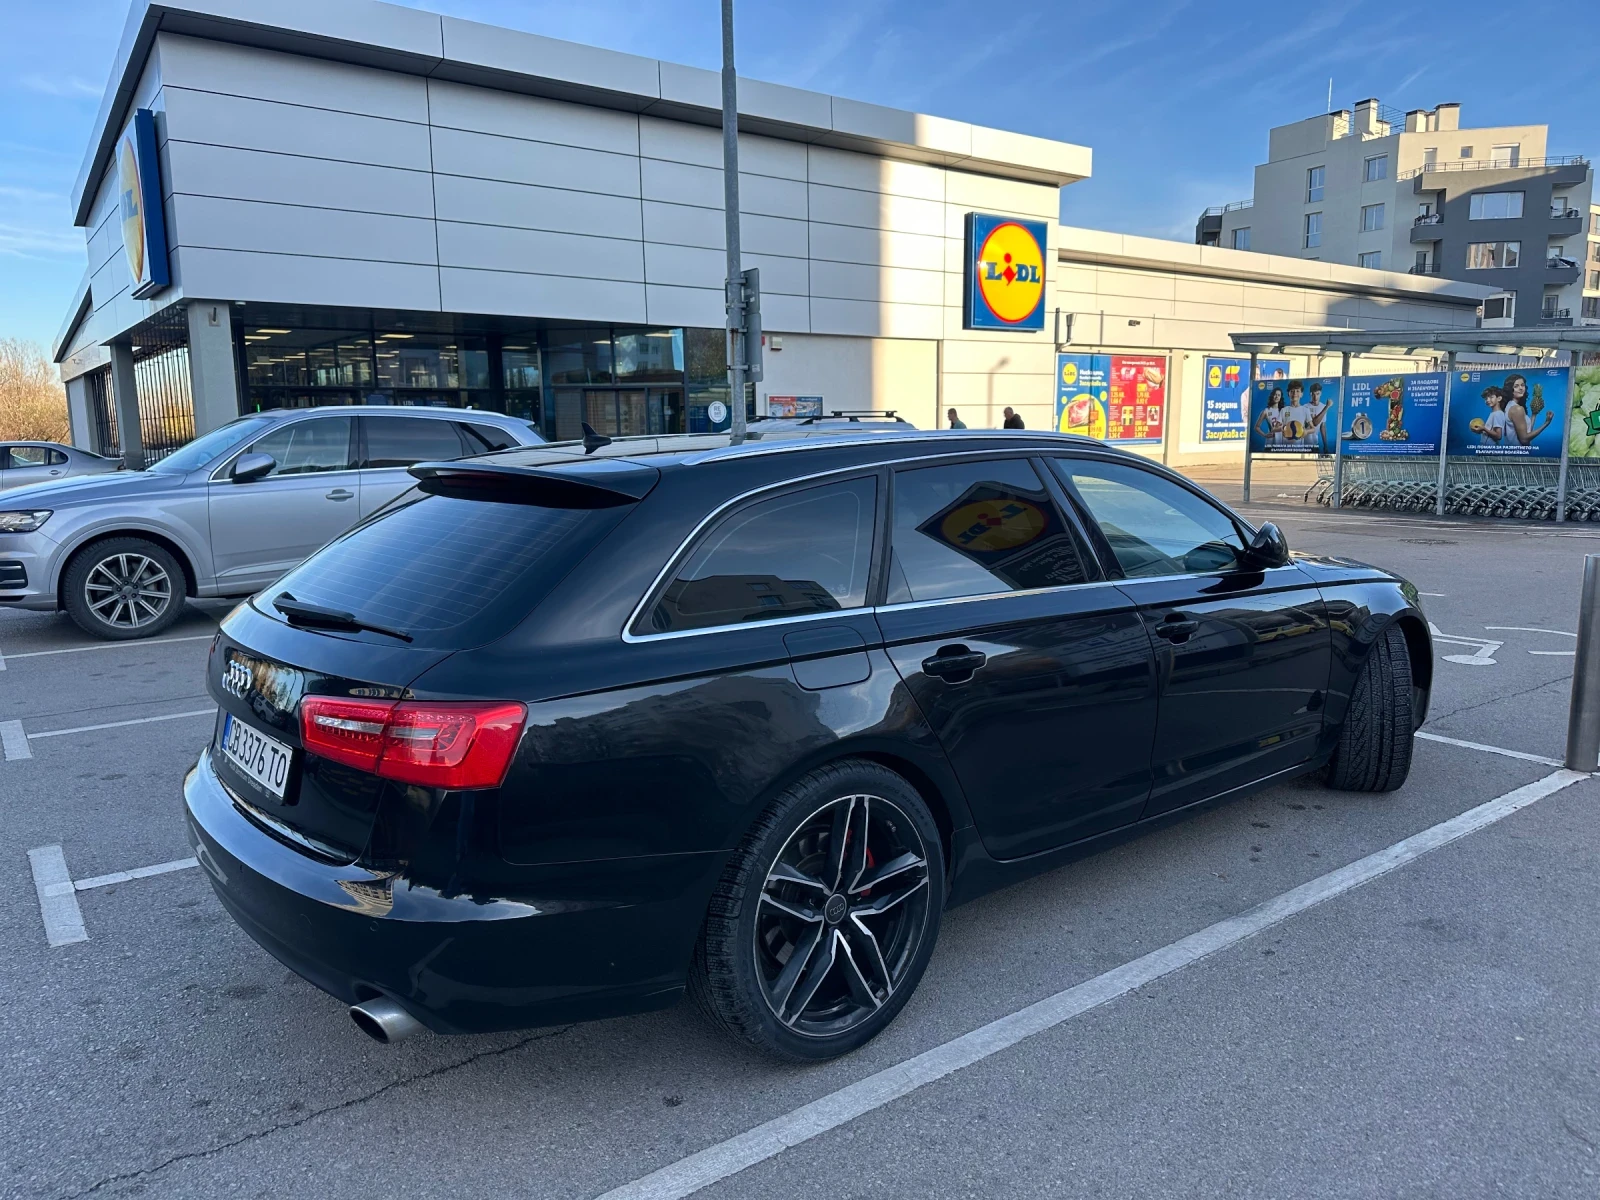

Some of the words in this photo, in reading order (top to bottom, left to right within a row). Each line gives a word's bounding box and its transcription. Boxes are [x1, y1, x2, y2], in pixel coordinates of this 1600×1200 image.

[1352, 382, 1371, 391] LIDL
[1207, 400, 1214, 409] 15
[1215, 402, 1238, 411] години
[1206, 410, 1229, 421] верига
[1206, 429, 1238, 440] Заслужава
[228, 719, 242, 756] CB
[239, 728, 267, 776] 3376
[268, 746, 286, 788] TO
